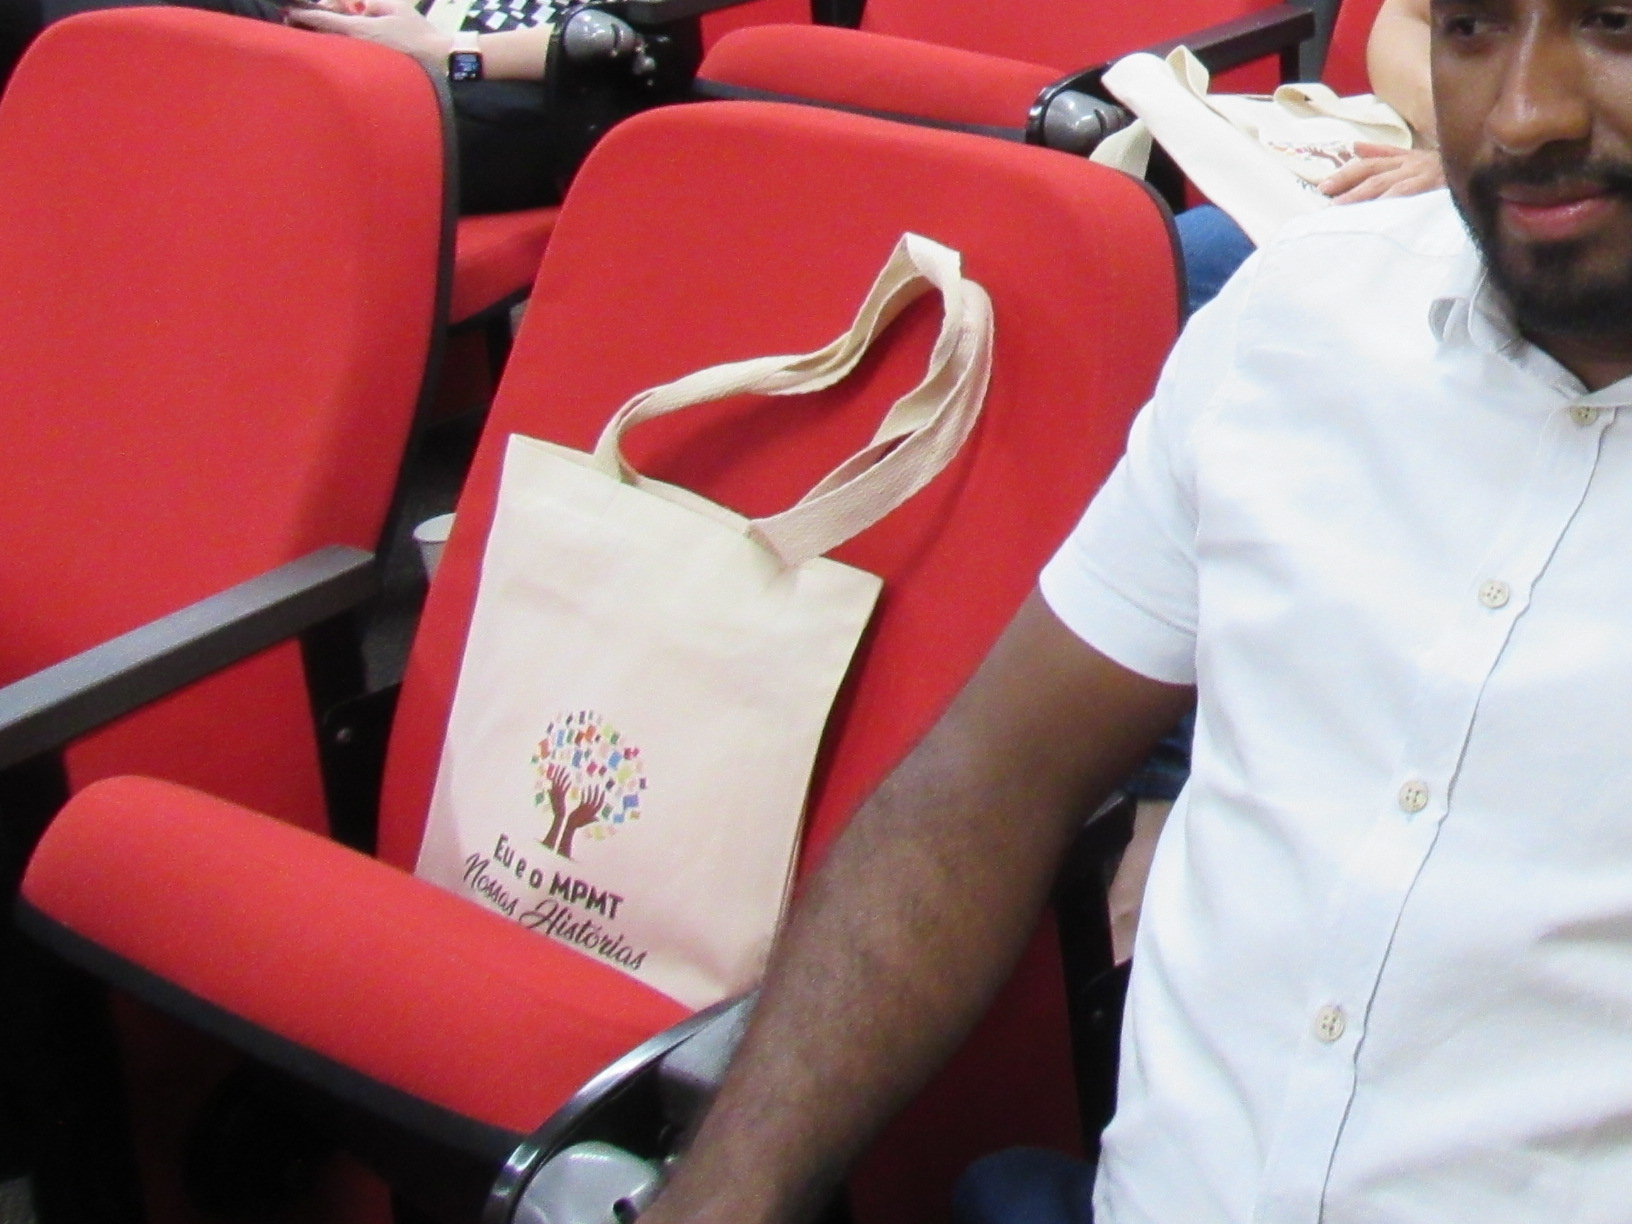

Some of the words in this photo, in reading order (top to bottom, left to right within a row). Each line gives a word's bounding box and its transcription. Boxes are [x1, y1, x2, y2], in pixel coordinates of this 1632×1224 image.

[463, 852, 520, 916] Nossas
[518, 898, 648, 970] Histórias
[493, 833, 516, 868] Eu
[515, 857, 527, 878] e
[529, 868, 543, 889] o
[550, 871, 624, 920] MPMT
